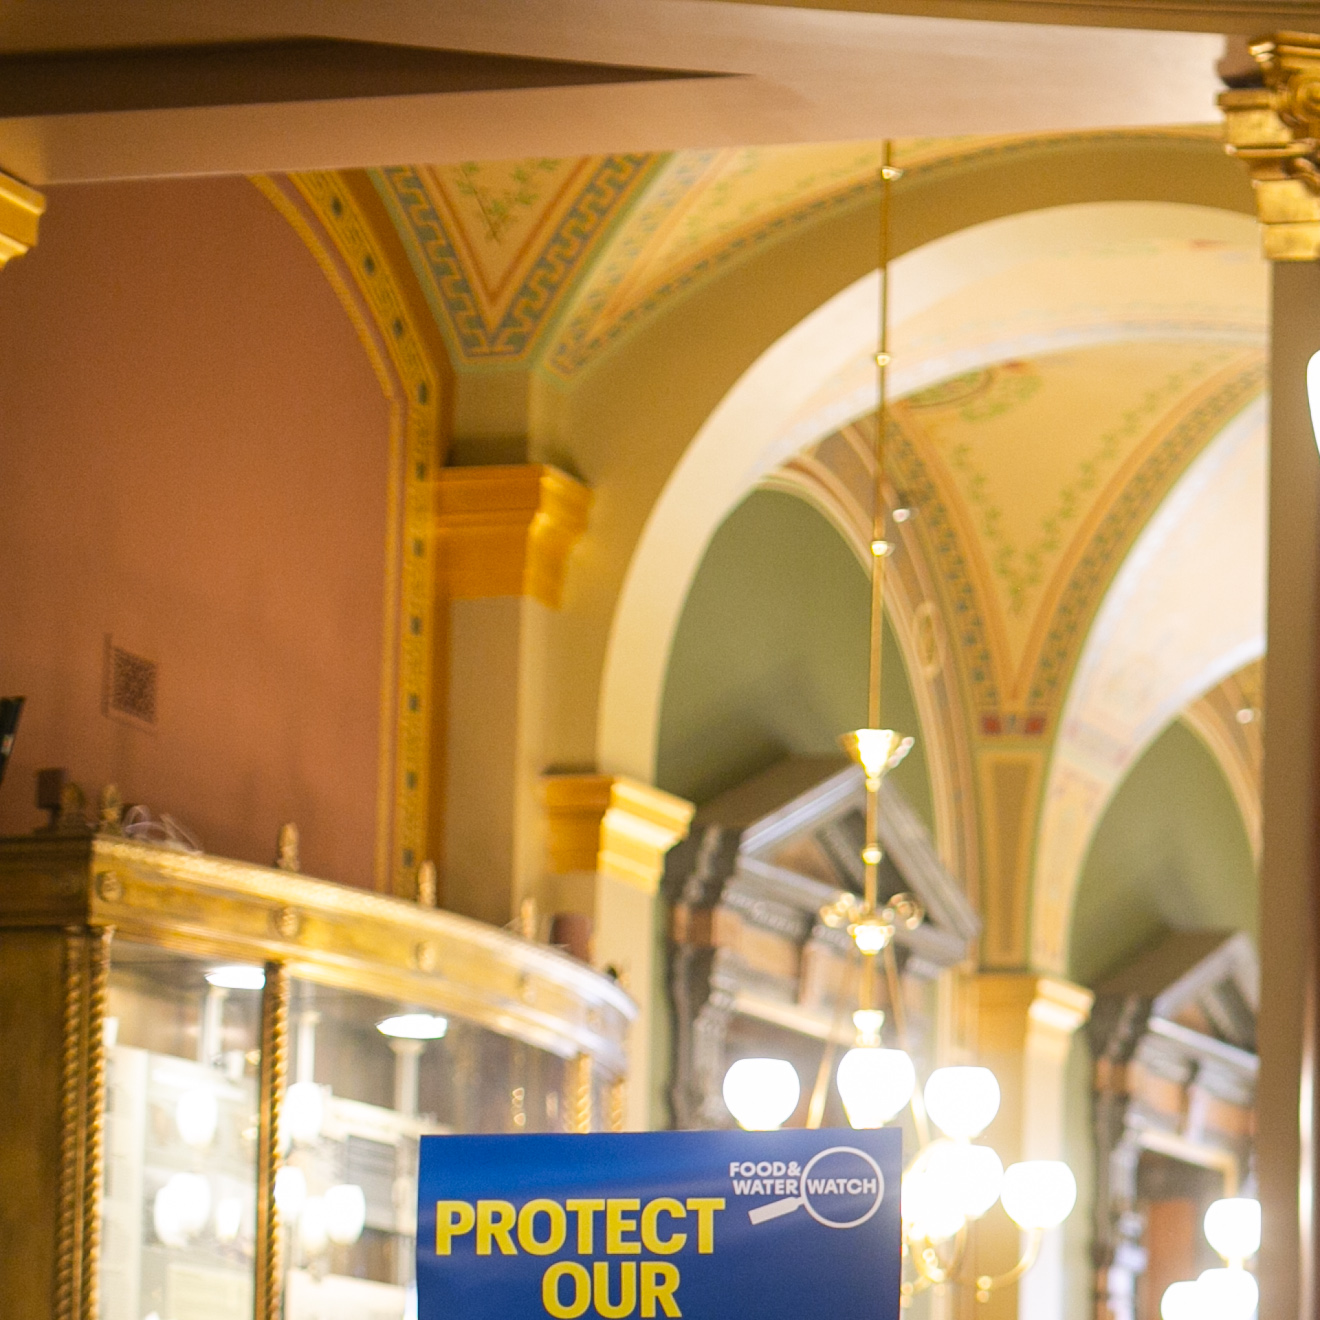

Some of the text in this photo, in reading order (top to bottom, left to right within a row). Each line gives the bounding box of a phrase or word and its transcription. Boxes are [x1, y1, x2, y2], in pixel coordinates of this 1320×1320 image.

[733, 1178, 877, 1195] WATER WATCH
[435, 1197, 726, 1256] PROTECT
[541, 1260, 683, 1320] OUR
